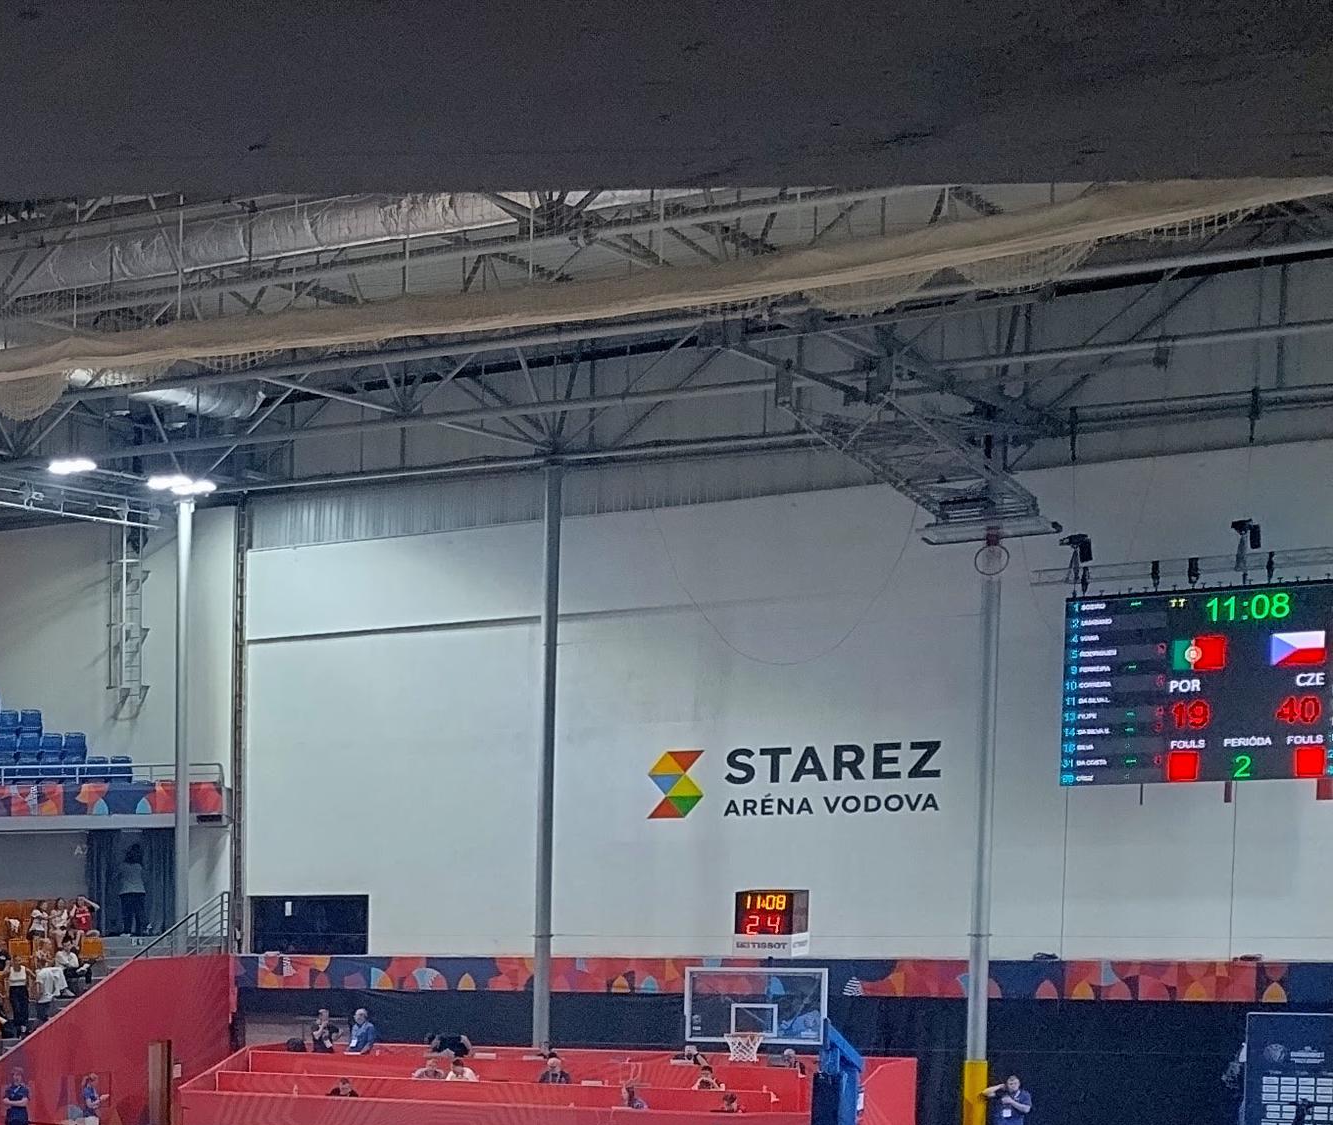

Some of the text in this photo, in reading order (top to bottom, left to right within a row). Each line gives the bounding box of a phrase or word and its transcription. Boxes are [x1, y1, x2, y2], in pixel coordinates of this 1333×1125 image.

[1206, 593, 1290, 622] 11:08
[1169, 680, 1202, 693] POR
[1296, 672, 1326, 686] CZE
[1172, 700, 1210, 730] 19
[1170, 740, 1207, 749] FOULS
[1286, 734, 1324, 745] FOULS
[724, 740, 942, 785] STAREZ
[1233, 755, 1252, 778] 2
[723, 793, 940, 817] ARÉNA VODOVA
[746, 915, 781, 935] 24
